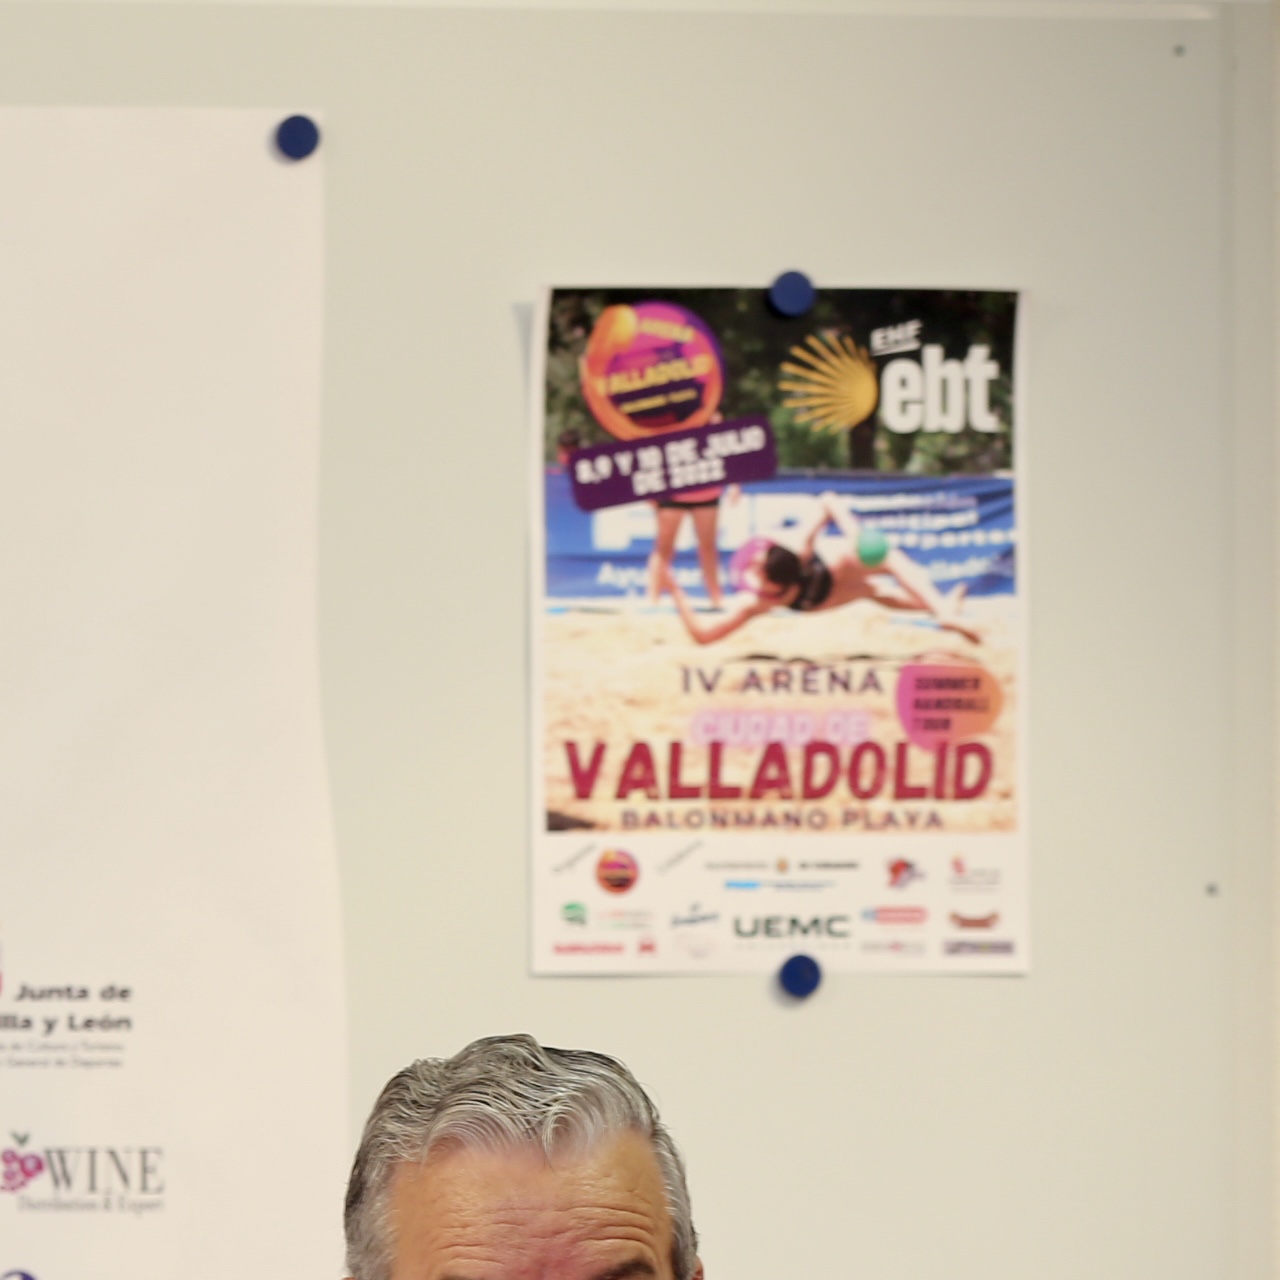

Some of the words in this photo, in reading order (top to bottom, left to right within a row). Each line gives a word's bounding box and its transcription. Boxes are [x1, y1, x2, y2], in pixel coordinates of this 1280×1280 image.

[870, 318, 923, 350] EHF
[880, 343, 1000, 434] ebt
[681, 667, 723, 694] IV
[742, 667, 886, 694] ARENA
[563, 739, 995, 801] VALLADOLID
[621, 808, 830, 831] BALONMANO
[841, 807, 945, 831] PLAYA
[732, 914, 851, 939] UEMC
[15, 983, 89, 1002] Junta
[99, 983, 132, 1001] de
[43, 1016, 58, 1036] y
[68, 1013, 132, 1031] León
[42, 1148, 166, 1194] WINE
